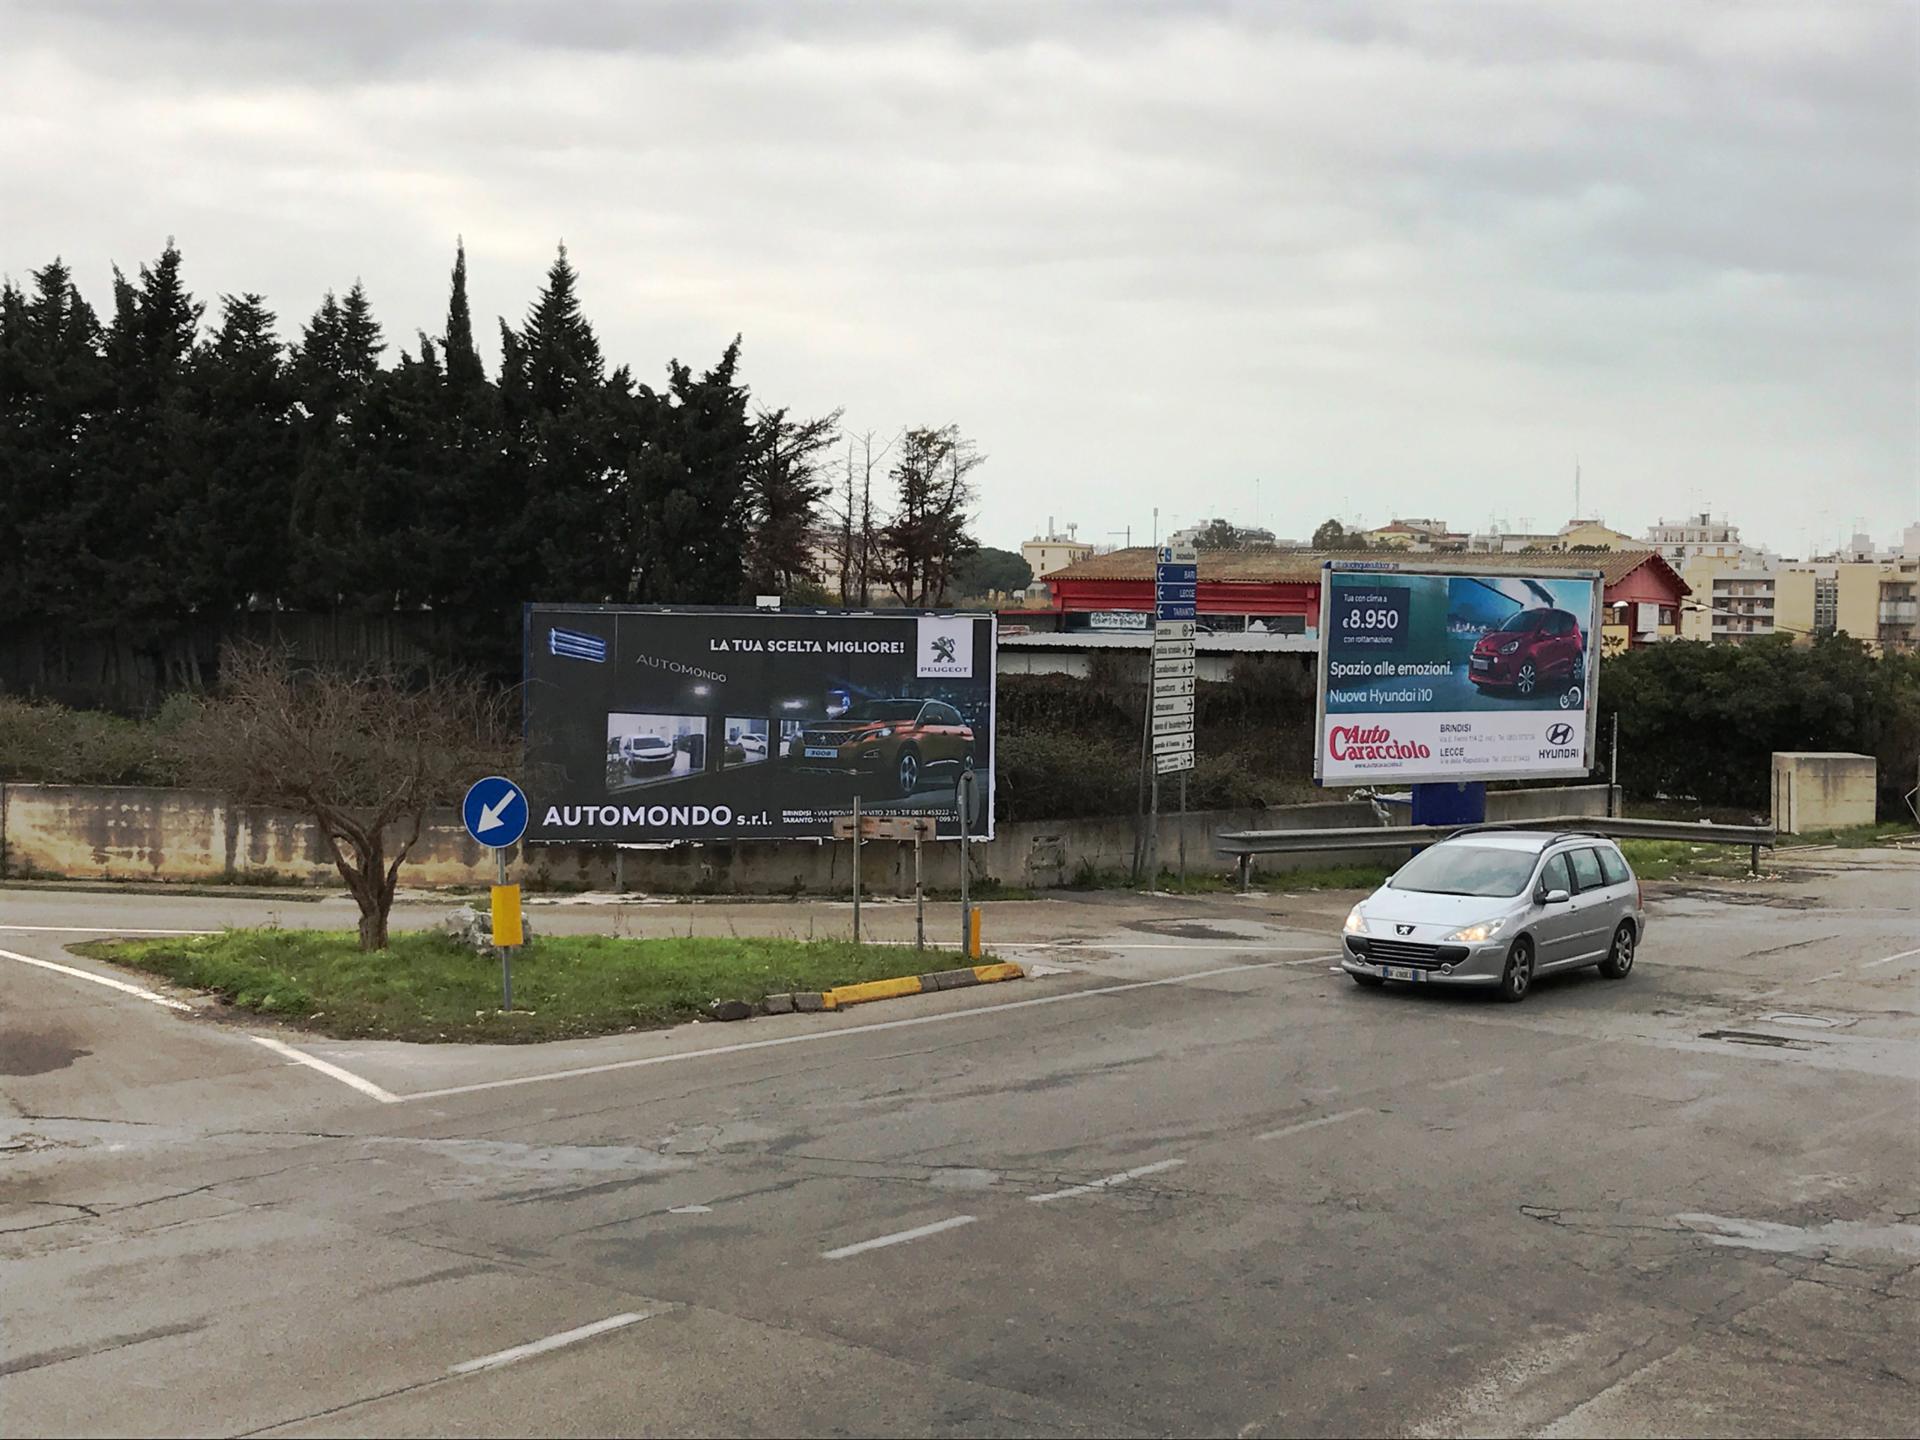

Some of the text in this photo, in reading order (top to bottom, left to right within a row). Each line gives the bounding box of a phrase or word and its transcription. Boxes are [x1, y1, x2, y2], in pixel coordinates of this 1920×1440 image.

[1342, 609, 1399, 629] €8.950
[710, 639, 905, 654] LA TUA SCELTA MIGLIORE!
[637, 654, 727, 682] AUTOMONDO
[1330, 661, 1453, 678] Spazio alle emozioni.
[1330, 688, 1432, 704] Nuova Hyundai i10
[1344, 725, 1390, 744] Auto
[1440, 724, 1471, 733] BRINDISI
[1330, 726, 1430, 761] Caracciolo
[1440, 748, 1464, 757] LECCE
[1539, 749, 1579, 759] HYUNDAI
[542, 805, 773, 826] AUTOMONDO s.r.l.
